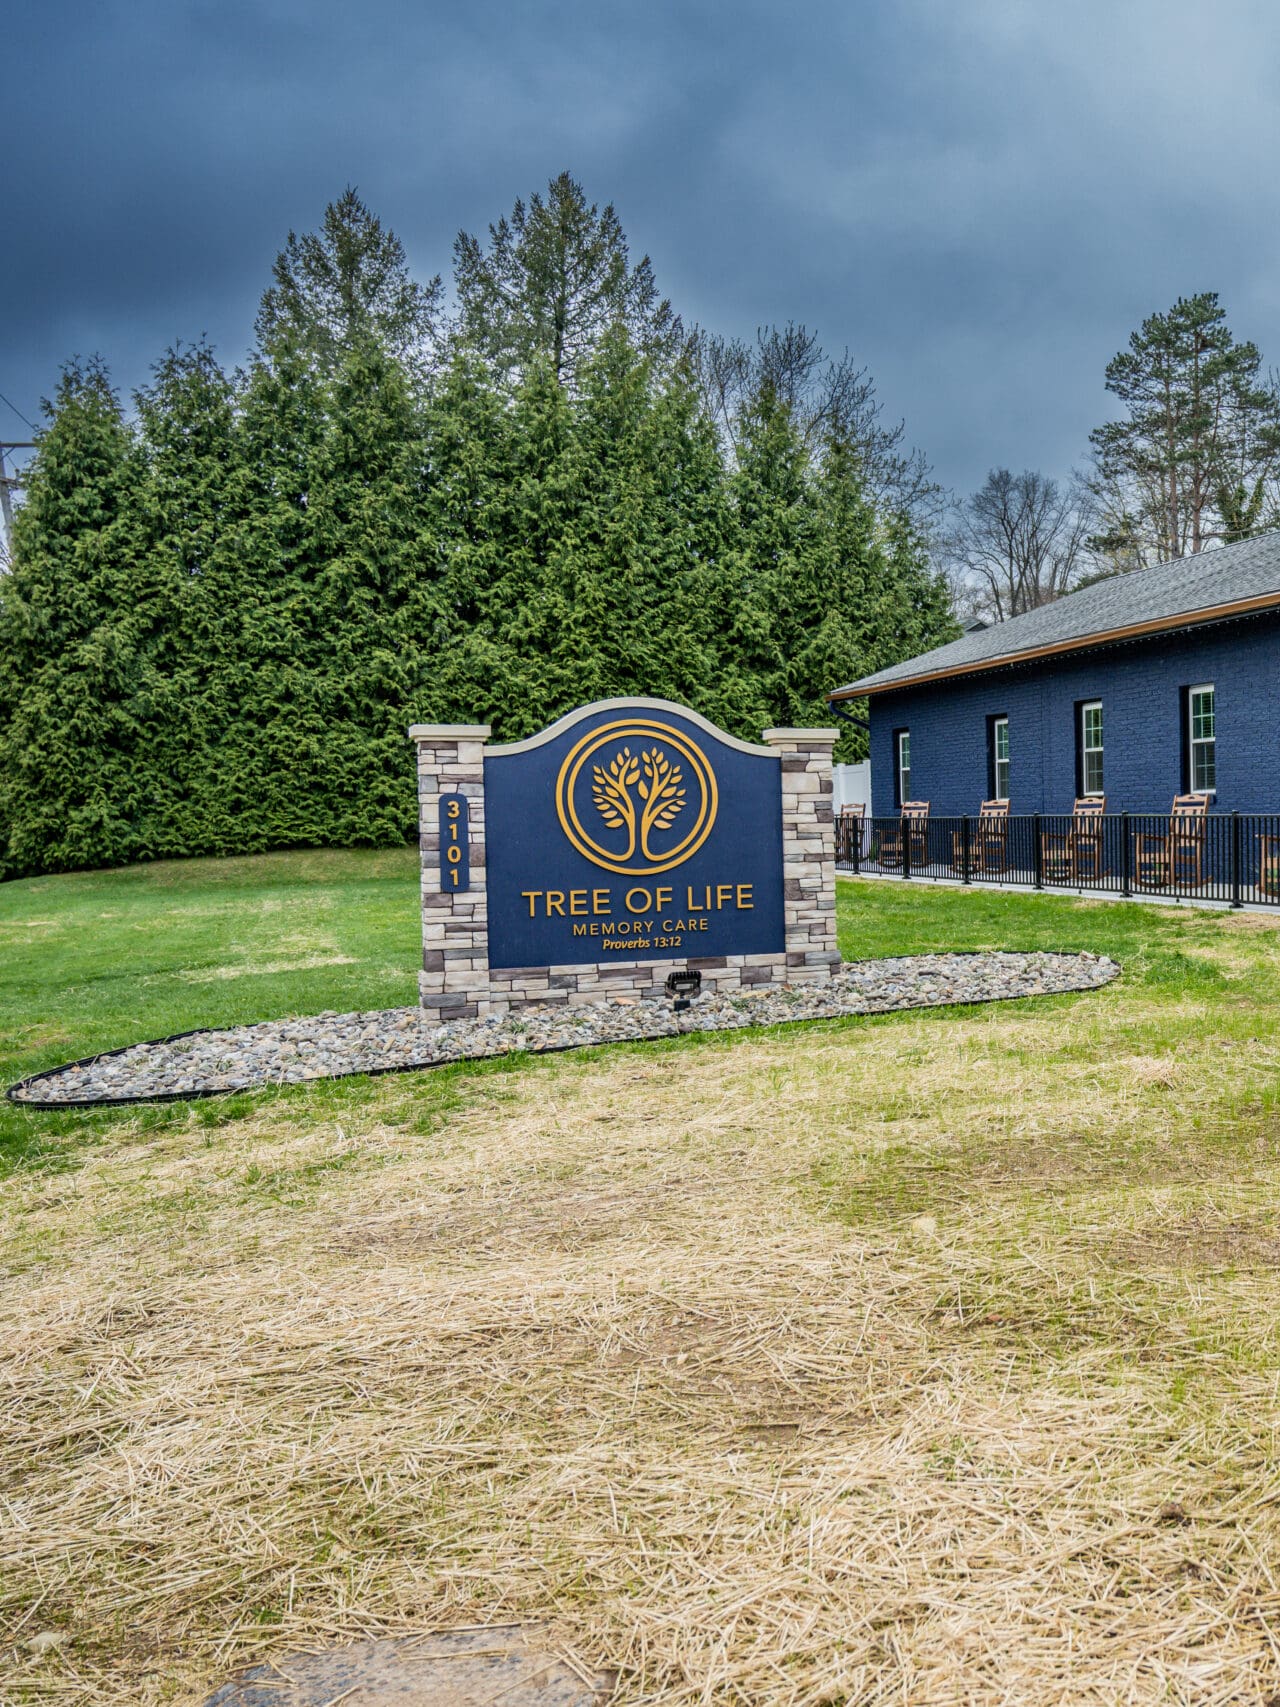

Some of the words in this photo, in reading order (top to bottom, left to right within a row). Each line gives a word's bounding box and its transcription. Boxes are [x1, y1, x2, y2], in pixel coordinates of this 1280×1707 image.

[447, 800, 462, 886] 3101
[521, 888, 612, 917] TREE
[625, 886, 673, 914] OF
[687, 884, 754, 911] LIFE
[573, 920, 655, 936] MEMORY
[662, 918, 709, 932] CARE
[602, 937, 651, 950] Proverbs
[653, 936, 682, 948] 13:12
